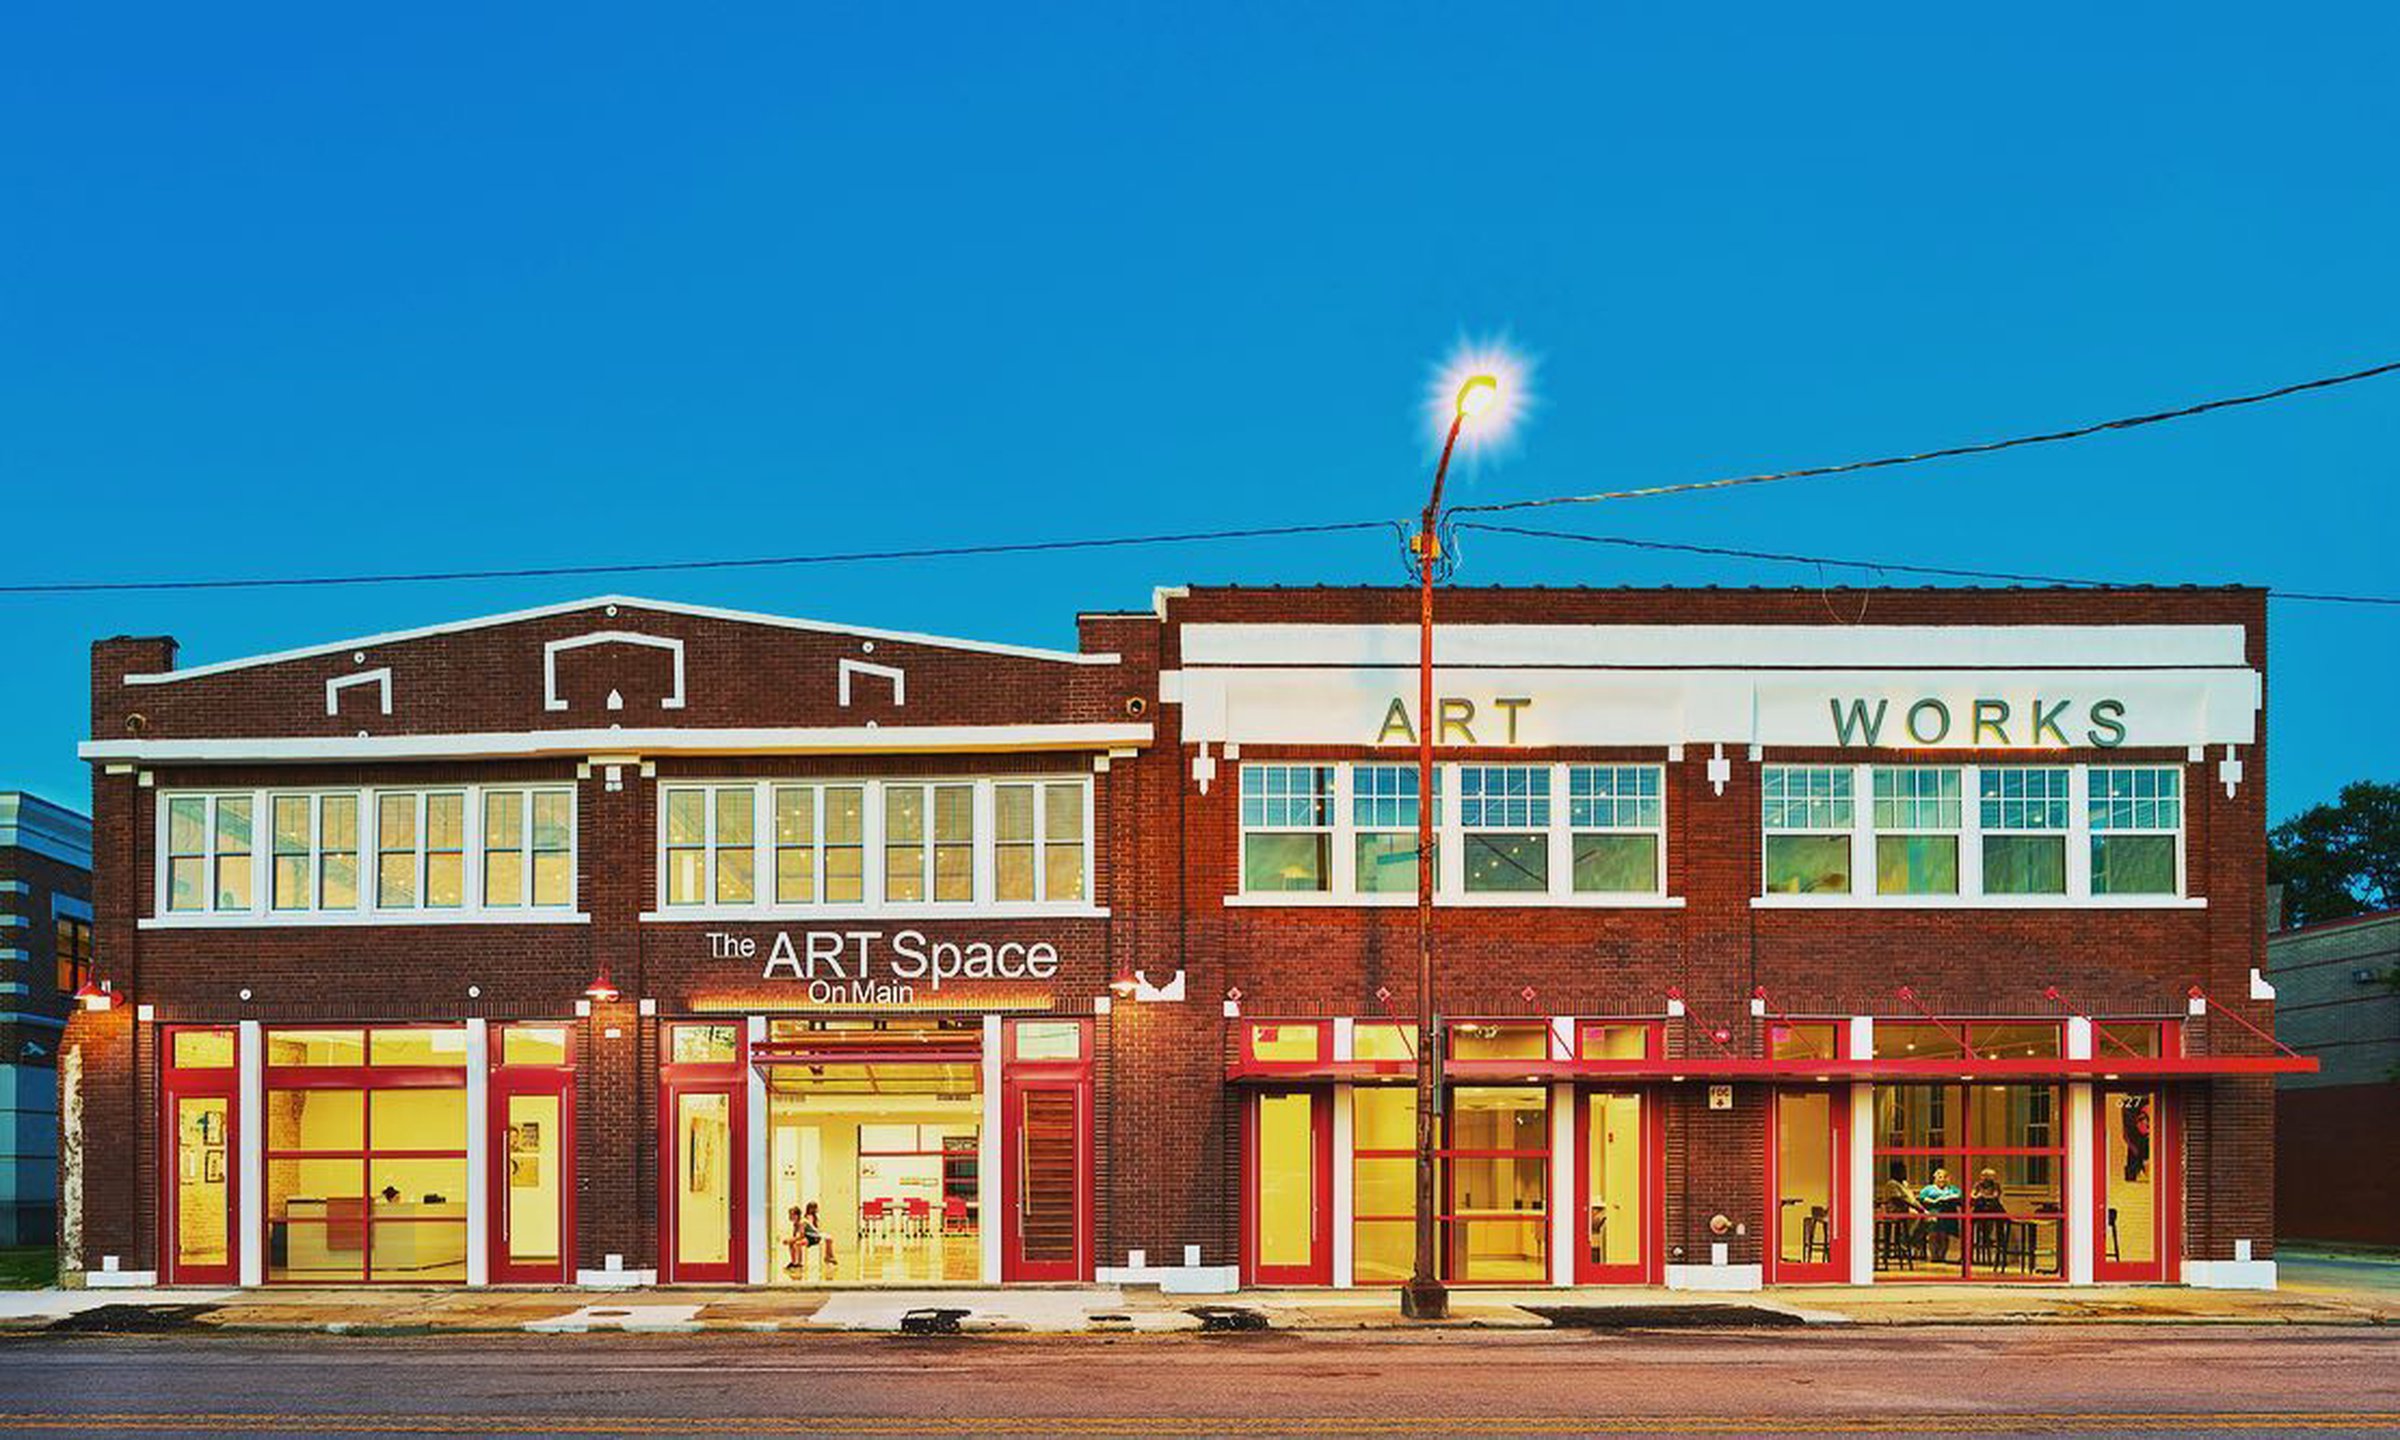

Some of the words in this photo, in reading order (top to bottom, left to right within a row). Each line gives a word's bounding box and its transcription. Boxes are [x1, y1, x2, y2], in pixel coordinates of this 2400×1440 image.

[1377, 697, 1532, 744] ART
[1830, 698, 2127, 748] WORKS
[707, 932, 756, 958] The
[763, 931, 882, 979] ART
[890, 929, 1058, 990] Space
[808, 980, 846, 1004] On
[851, 980, 914, 1004] Main
